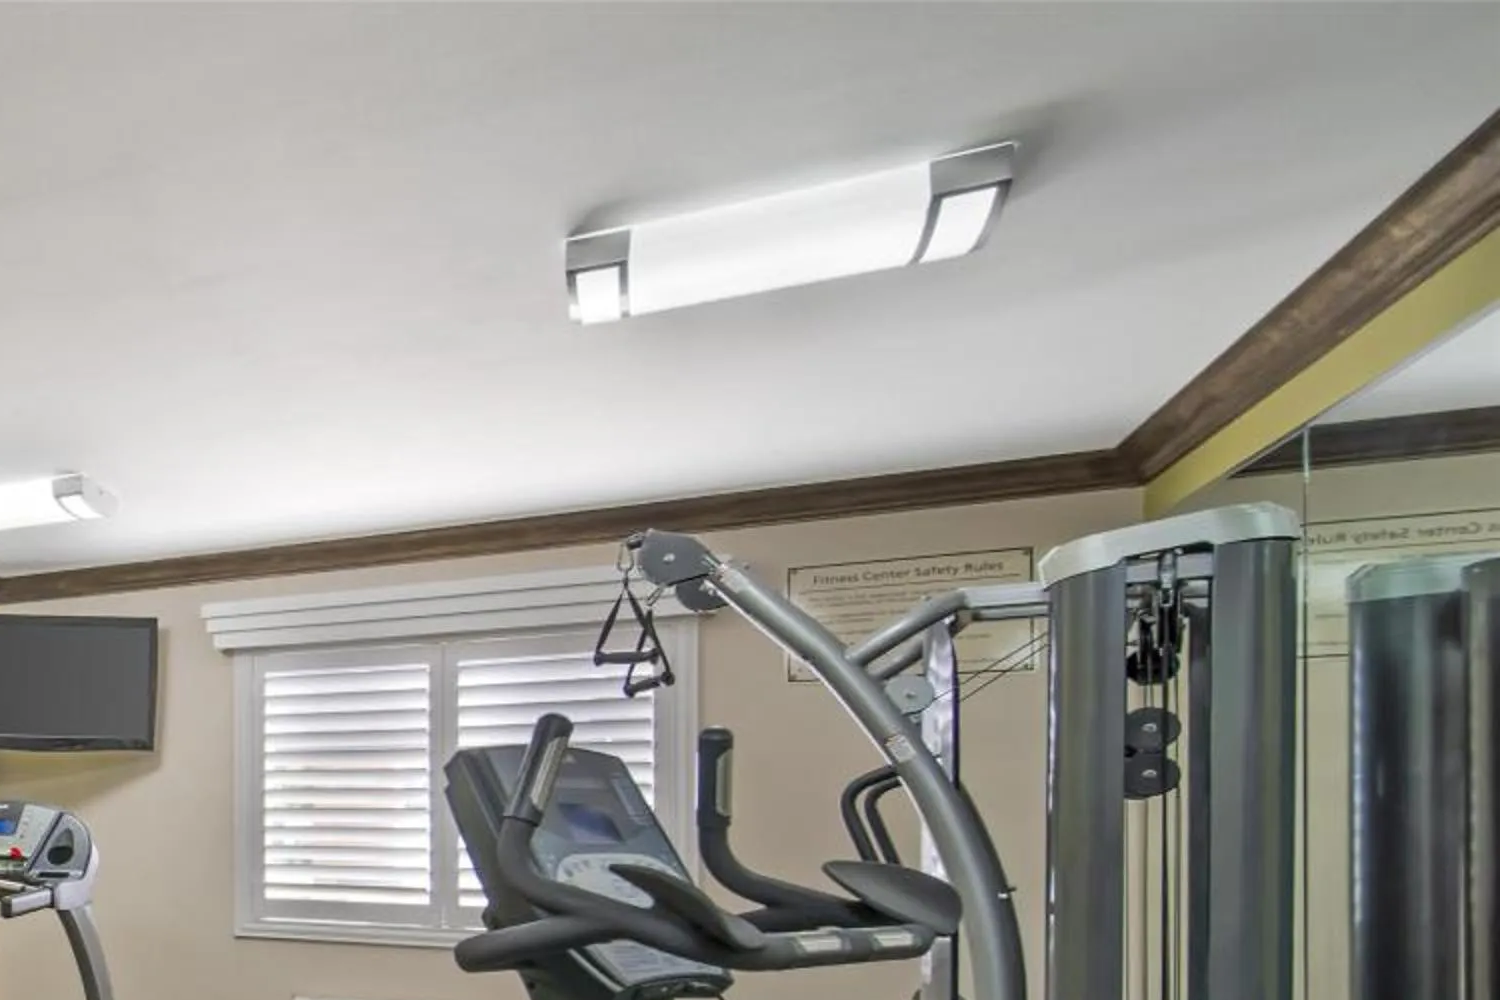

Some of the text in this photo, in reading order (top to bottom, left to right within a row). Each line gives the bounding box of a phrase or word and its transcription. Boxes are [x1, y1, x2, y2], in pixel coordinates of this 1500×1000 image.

[813, 561, 1005, 585] Fitness Center Safety Rules
